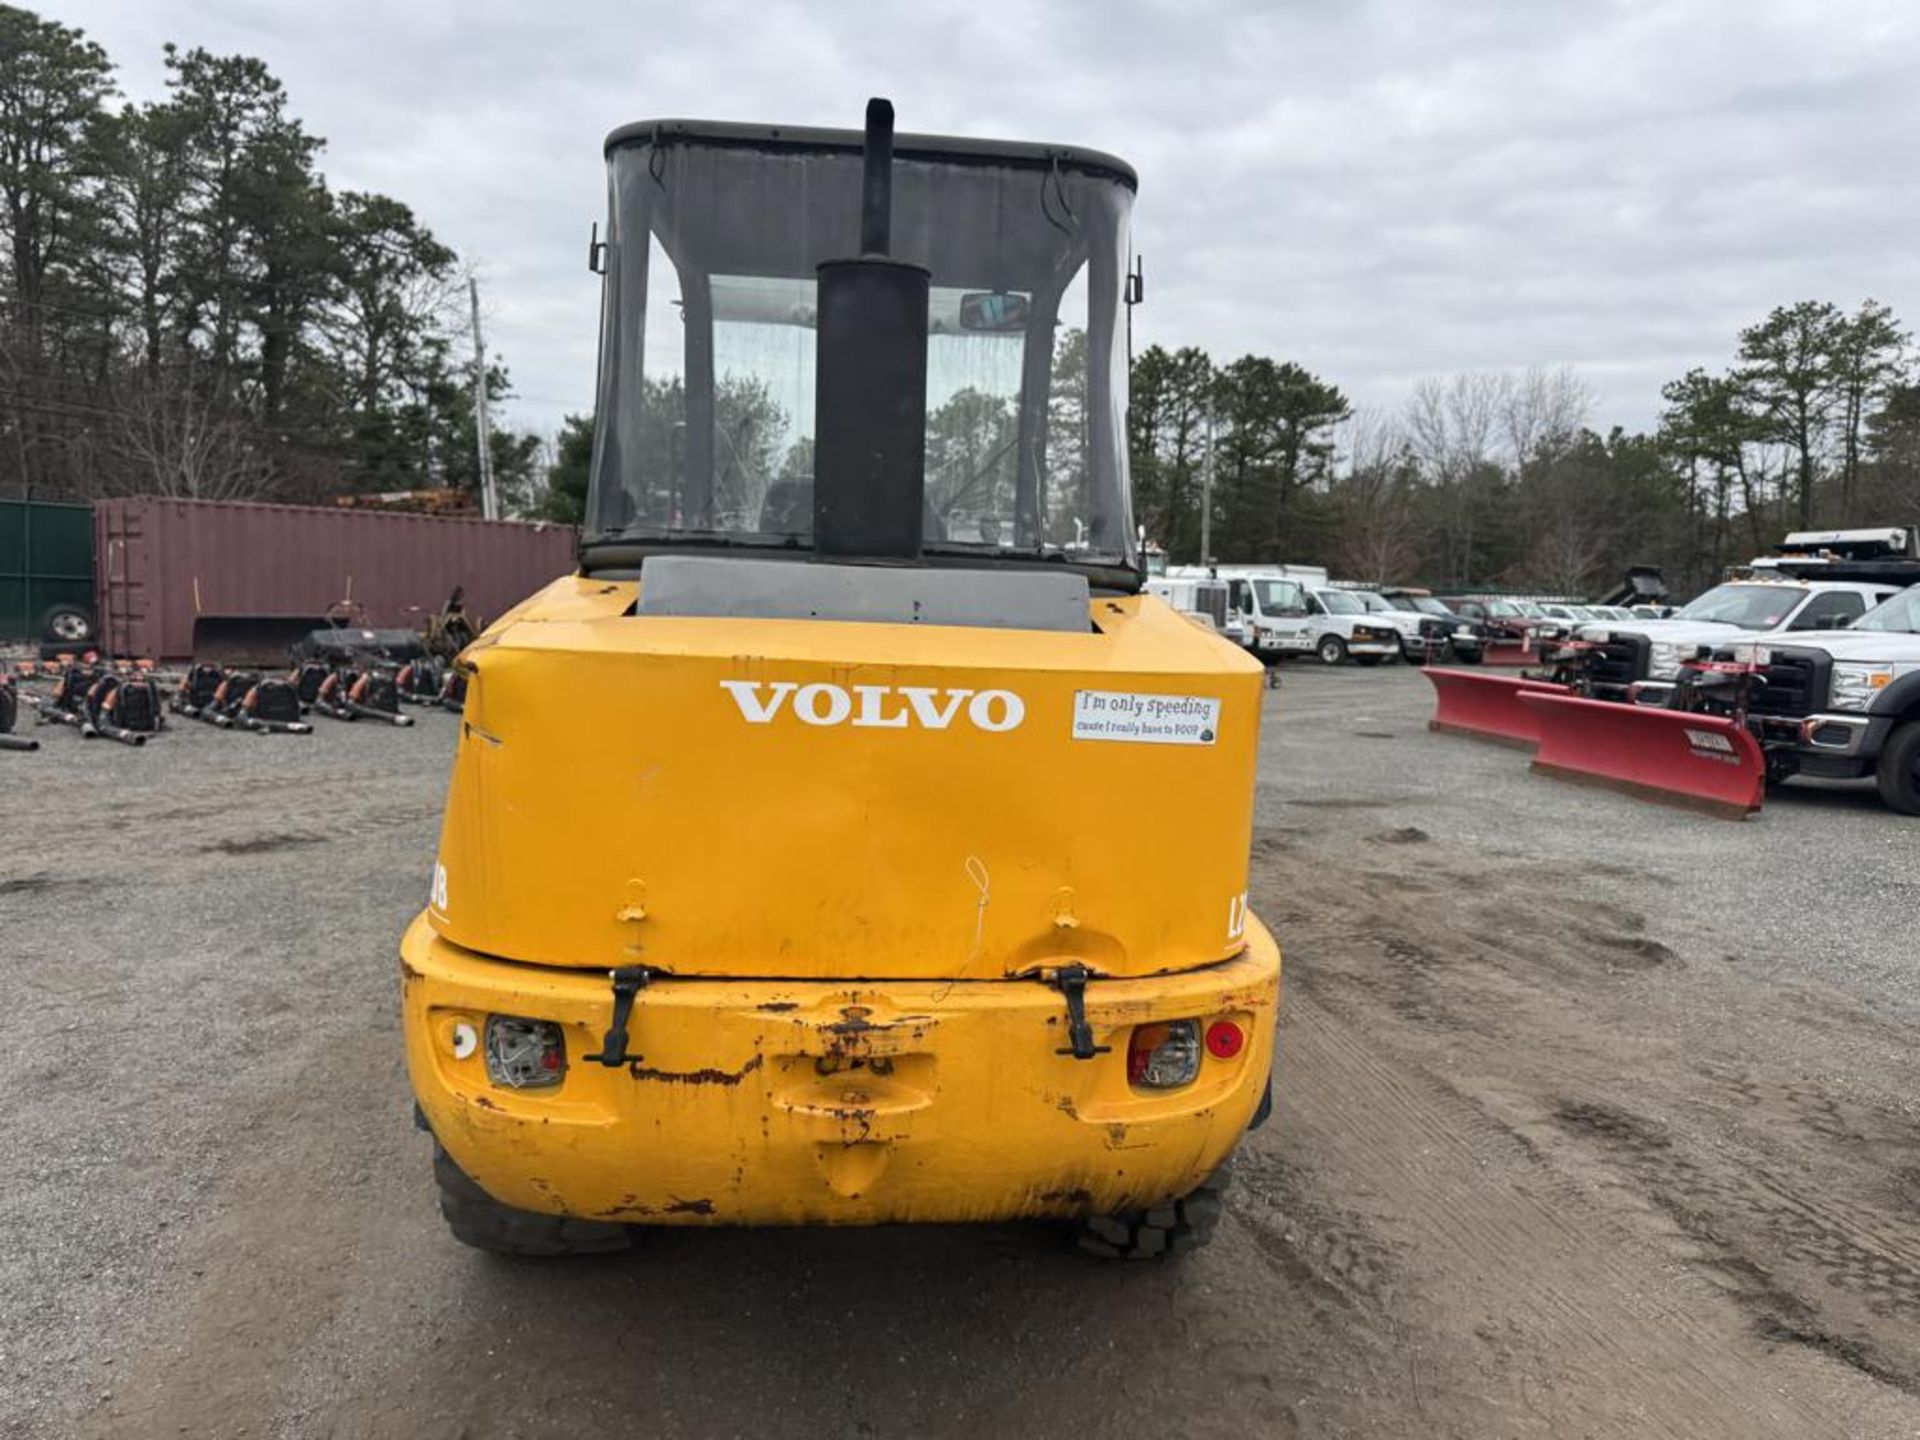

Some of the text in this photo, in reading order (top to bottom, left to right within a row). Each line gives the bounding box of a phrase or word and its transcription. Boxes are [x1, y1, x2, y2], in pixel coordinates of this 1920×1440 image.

[719, 679, 1025, 732] VOLVO
[1082, 692, 1211, 720] I'm only speeding
[1111, 723, 1140, 736] really
[1141, 722, 1163, 734] have
[1164, 725, 1173, 735] to
